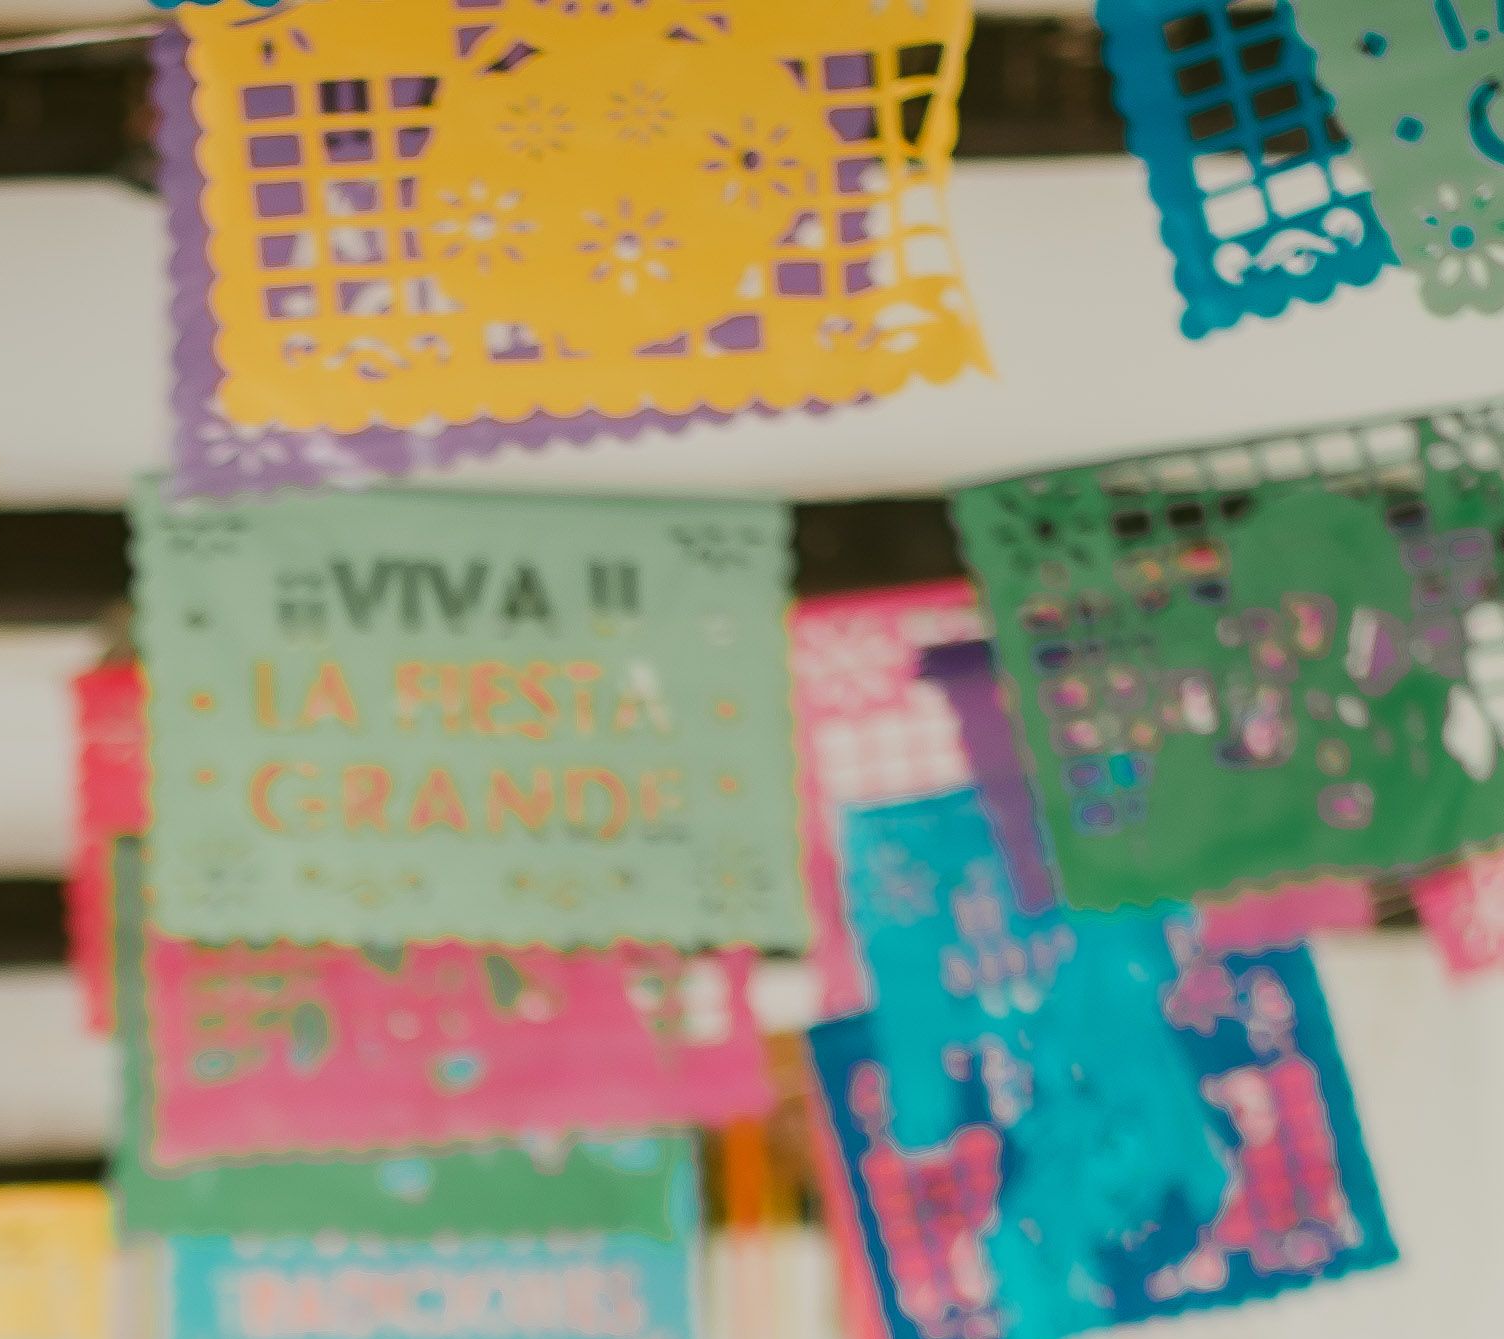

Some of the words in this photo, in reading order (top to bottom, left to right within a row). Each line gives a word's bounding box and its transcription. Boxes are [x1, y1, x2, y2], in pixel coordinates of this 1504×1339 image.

[252, 660, 362, 732] LA
[392, 658, 676, 740] FIESTA
[248, 760, 688, 842] GRANDE
